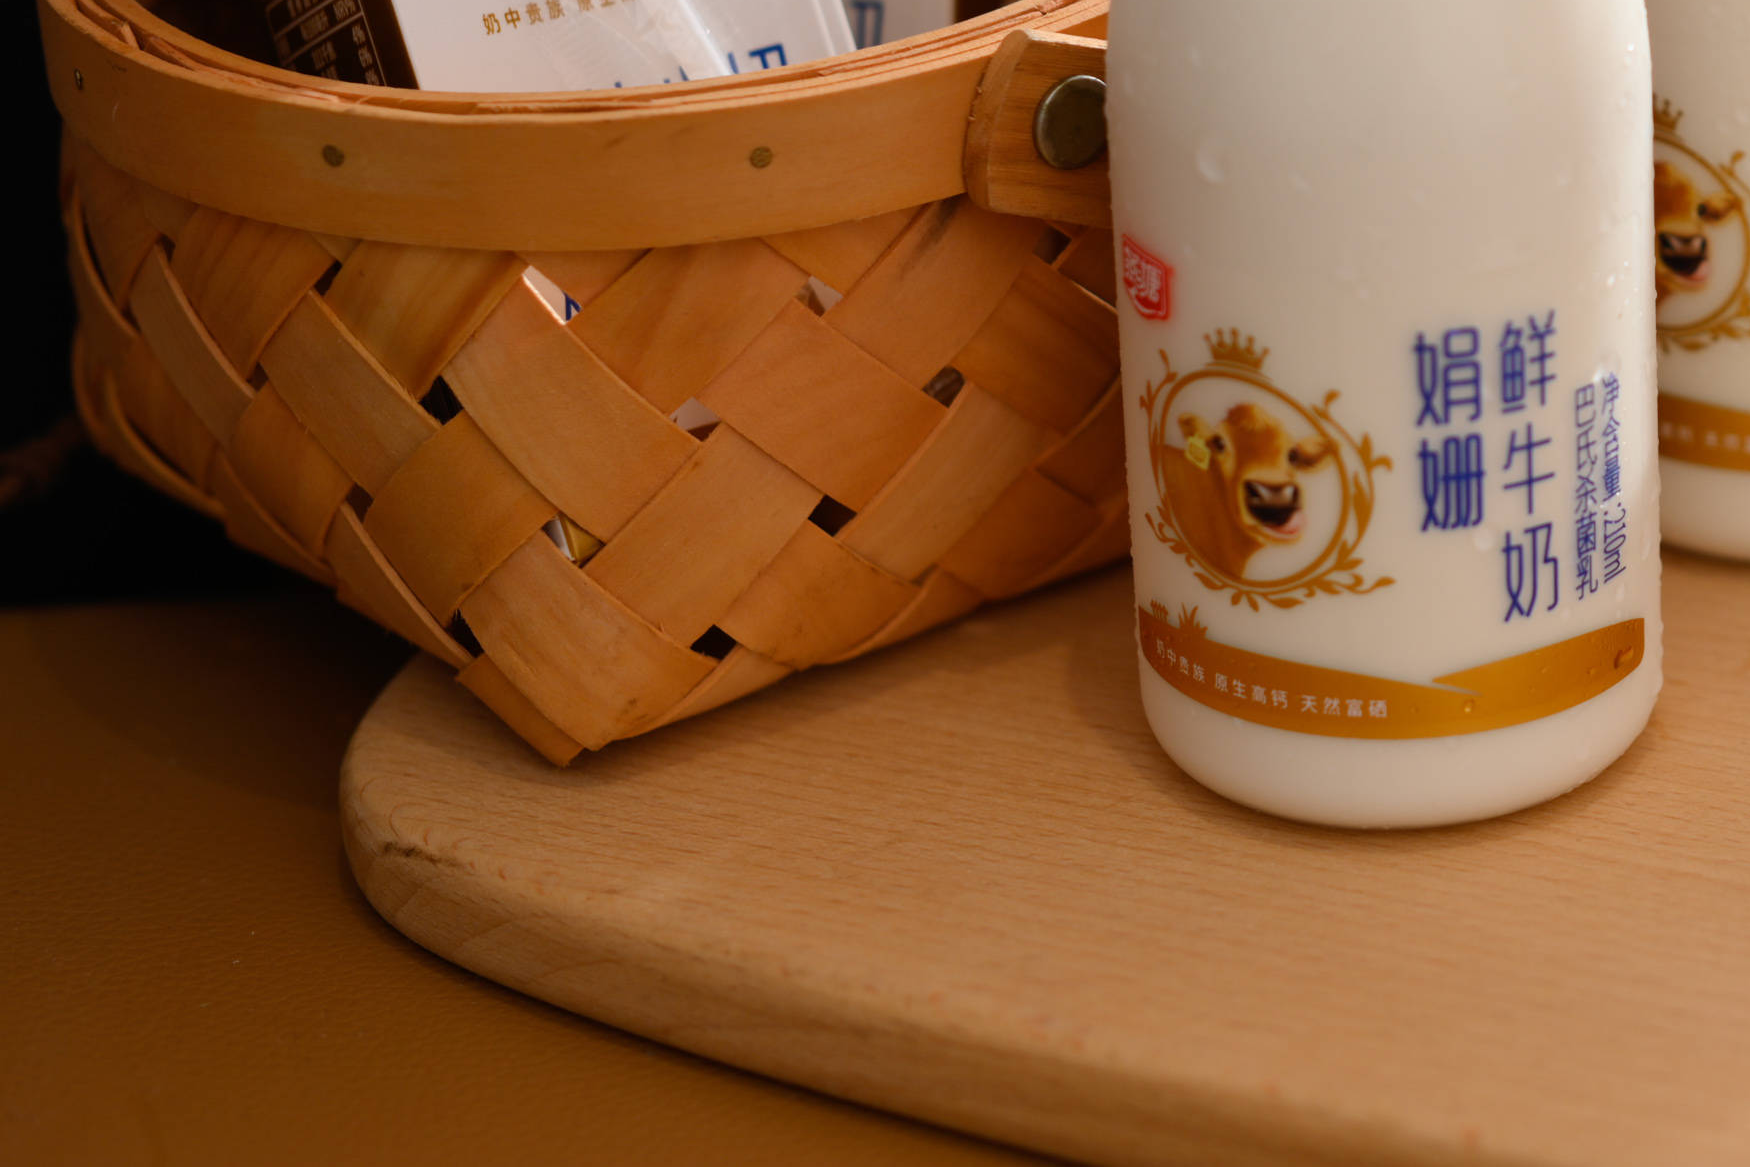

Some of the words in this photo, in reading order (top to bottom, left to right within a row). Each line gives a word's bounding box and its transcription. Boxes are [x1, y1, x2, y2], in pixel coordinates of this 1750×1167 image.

[1414, 327, 1486, 533] 娟姗
[1500, 310, 1560, 623] 鲜牛奶
[1574, 383, 1600, 602] 巴氏杀菌乳
[1214, 672, 1289, 710] 原生高钙
[1300, 693, 1388, 719] 天然富硒
